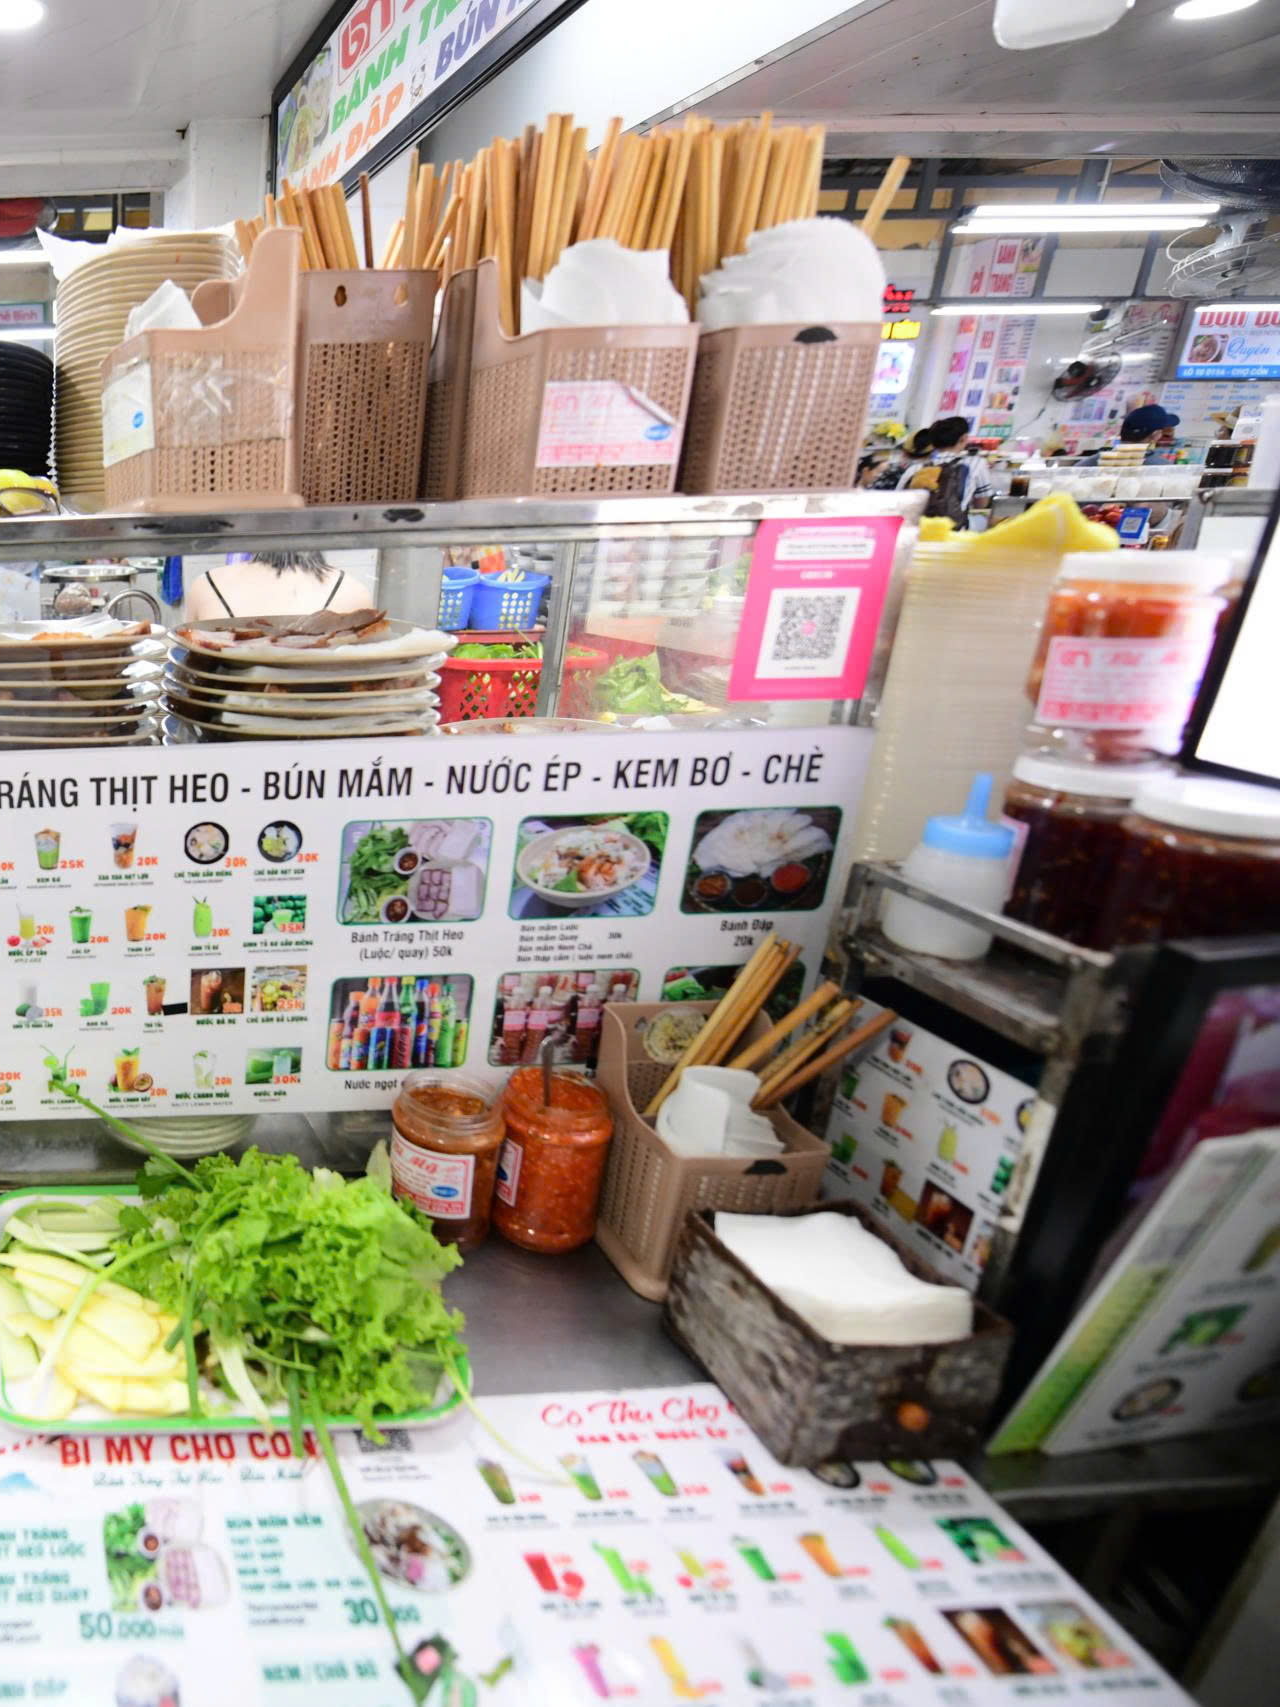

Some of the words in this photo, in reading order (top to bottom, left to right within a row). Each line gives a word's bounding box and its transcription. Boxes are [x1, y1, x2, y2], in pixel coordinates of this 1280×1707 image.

[331, 23, 411, 134] BÁNH
[89, 776, 158, 813] THỊT
[169, 772, 229, 804] HEO
[262, 763, 327, 800] BÚN
[337, 756, 413, 798] MẮM
[446, 756, 532, 794] NƯỚC
[542, 753, 582, 791] ÉP
[613, 758, 680, 789] KEM
[689, 752, 733, 786] BƠ
[762, 745, 824, 784] CHÈ
[351, 931, 379, 943] Bánh
[384, 931, 415, 944] Tráng
[445, 929, 464, 941] Heo
[433, 946, 453, 958] 50k
